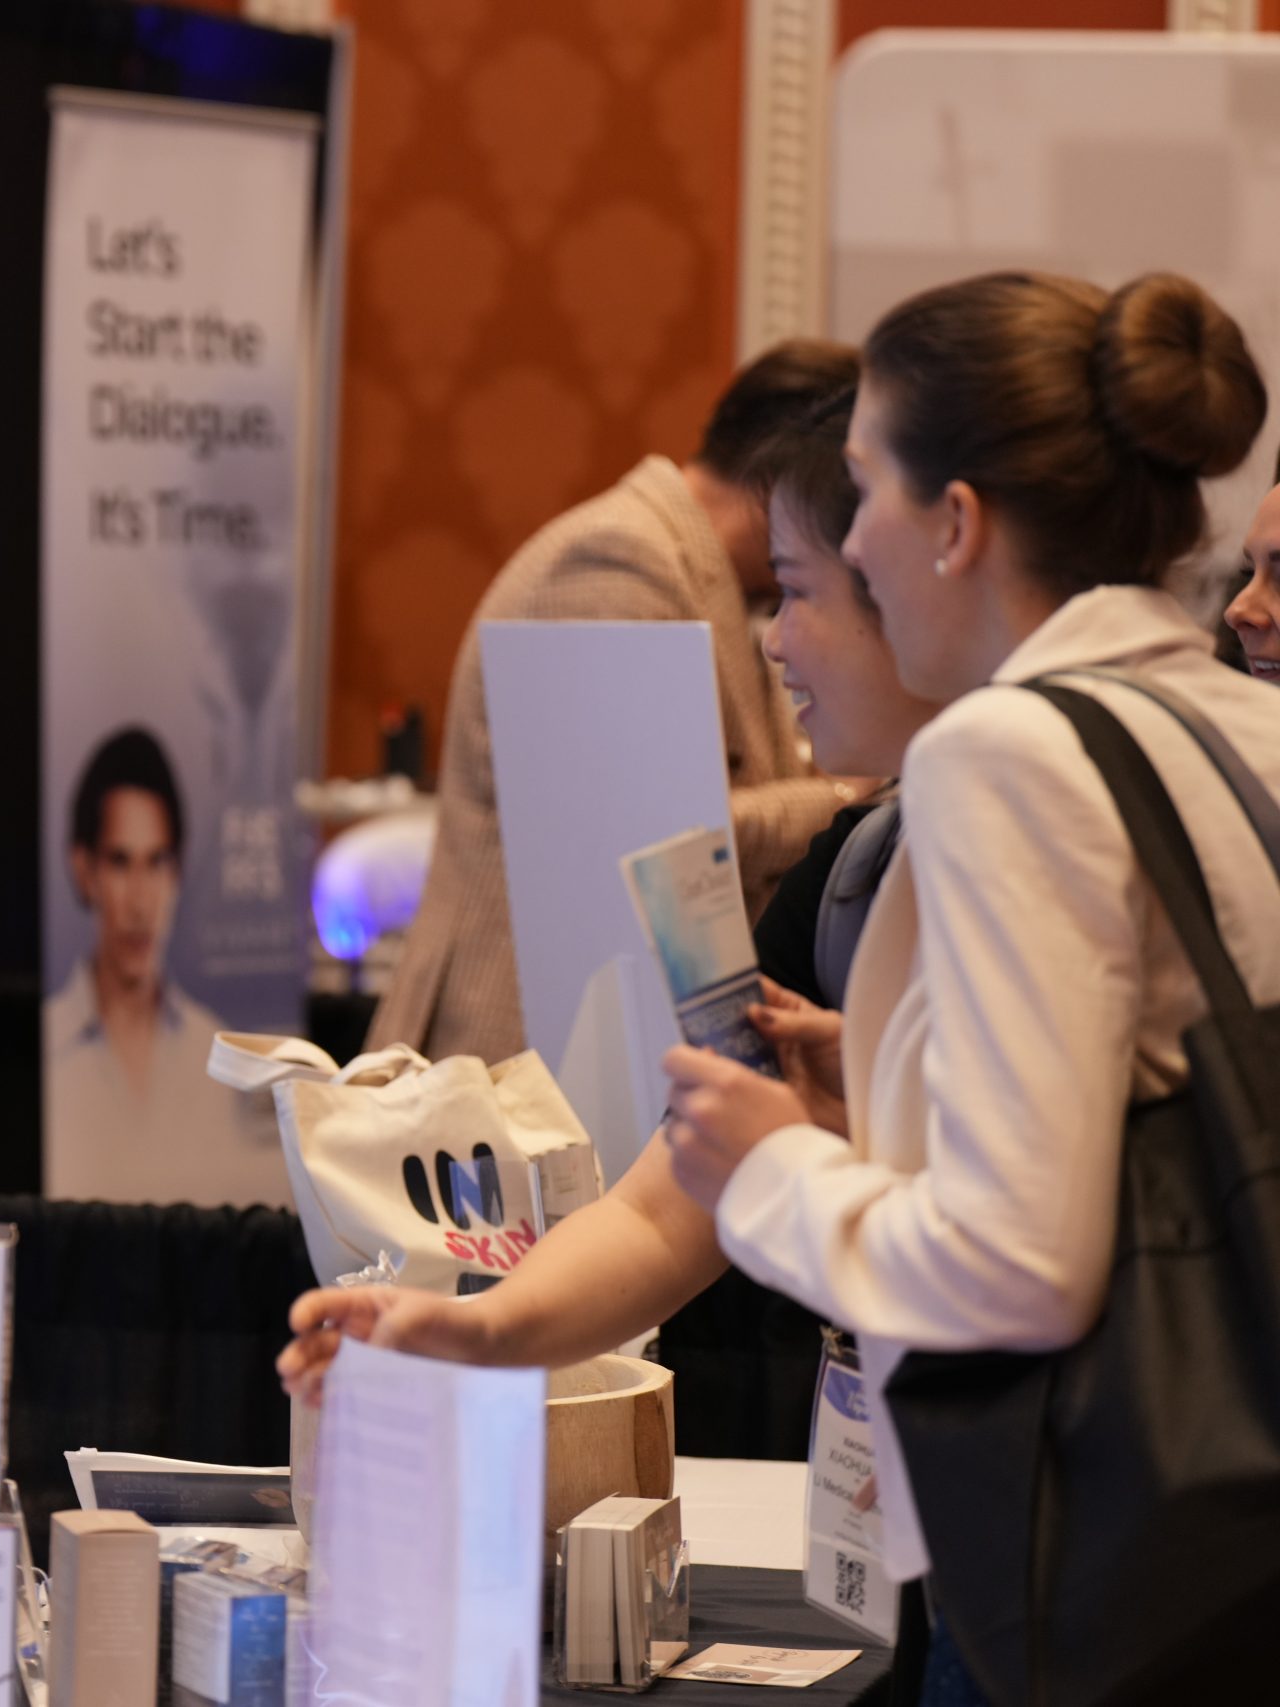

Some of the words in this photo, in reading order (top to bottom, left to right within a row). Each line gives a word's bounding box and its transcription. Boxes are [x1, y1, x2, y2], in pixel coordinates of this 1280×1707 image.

[86, 217, 181, 278] Let's
[87, 300, 186, 362] Start
[191, 308, 264, 366] the
[89, 384, 284, 461] Dialogue.
[91, 488, 146, 548] It's
[445, 1218, 537, 1272] SKIN
